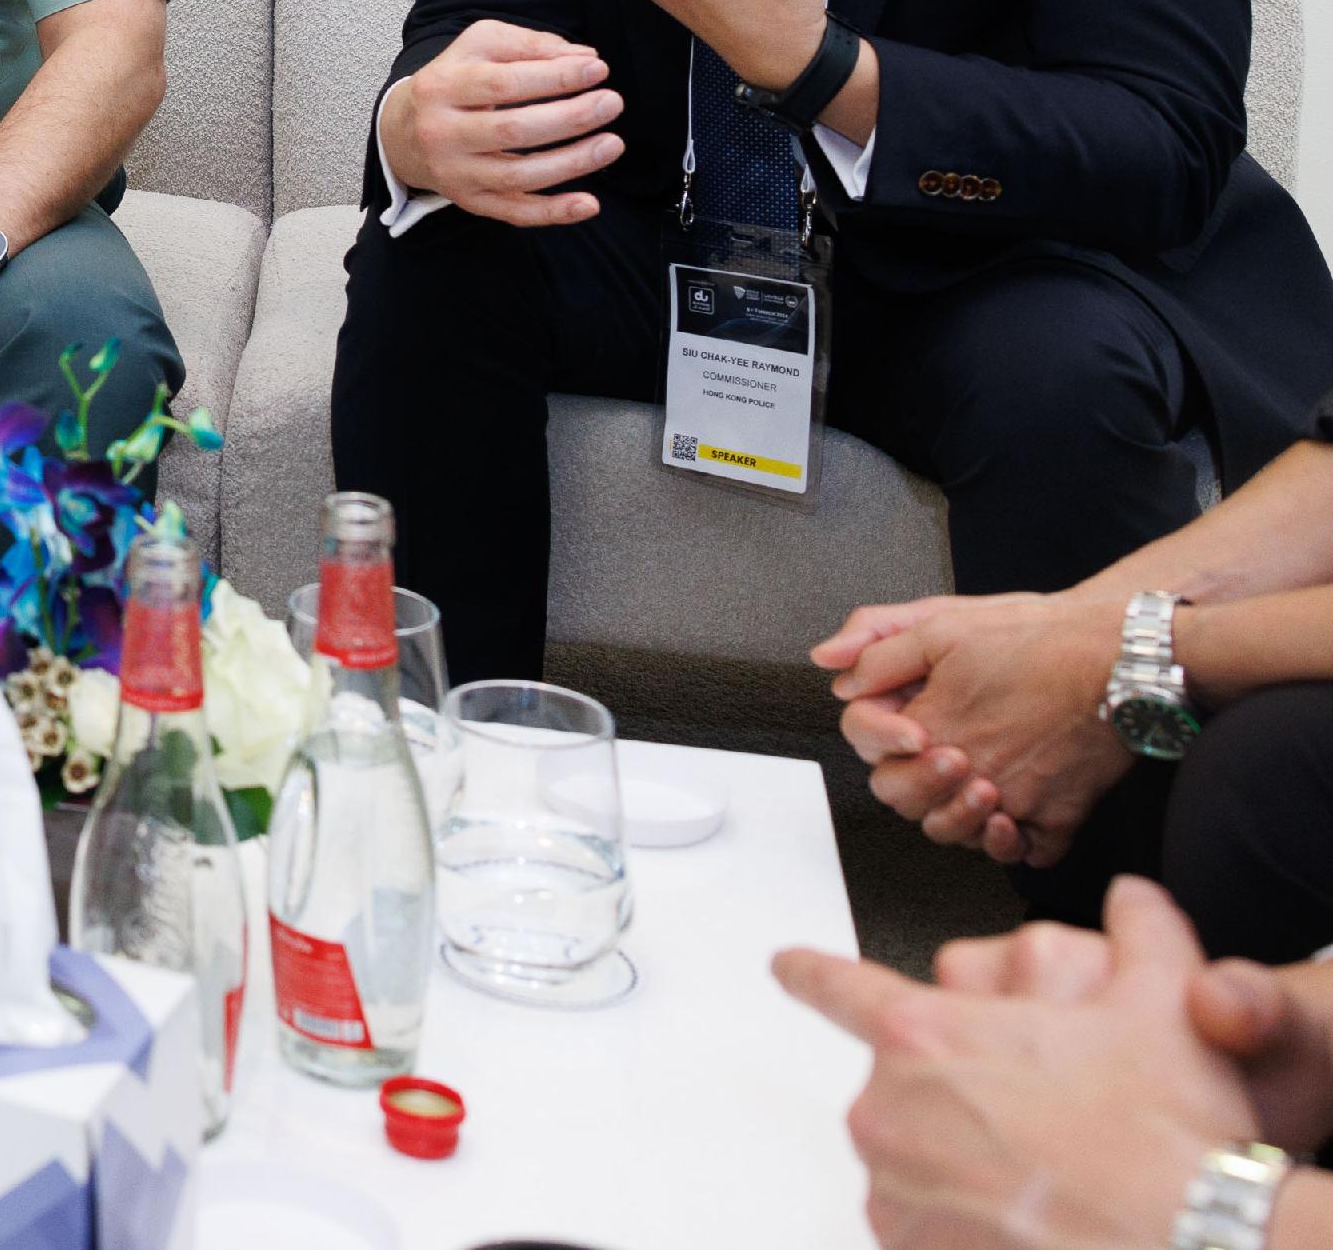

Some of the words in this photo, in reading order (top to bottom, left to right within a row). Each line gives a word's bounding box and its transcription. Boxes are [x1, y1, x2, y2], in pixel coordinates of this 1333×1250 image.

[682, 347, 698, 358] SIU
[700, 351, 749, 367] CHAK-YEE
[751, 360, 800, 377] RAYMOND
[702, 370, 777, 391] COMMISSIONER
[702, 389, 724, 399] HONG
[725, 394, 747, 405] KONG
[748, 398, 775, 409] POLICE
[711, 449, 757, 467] SPEAKER
